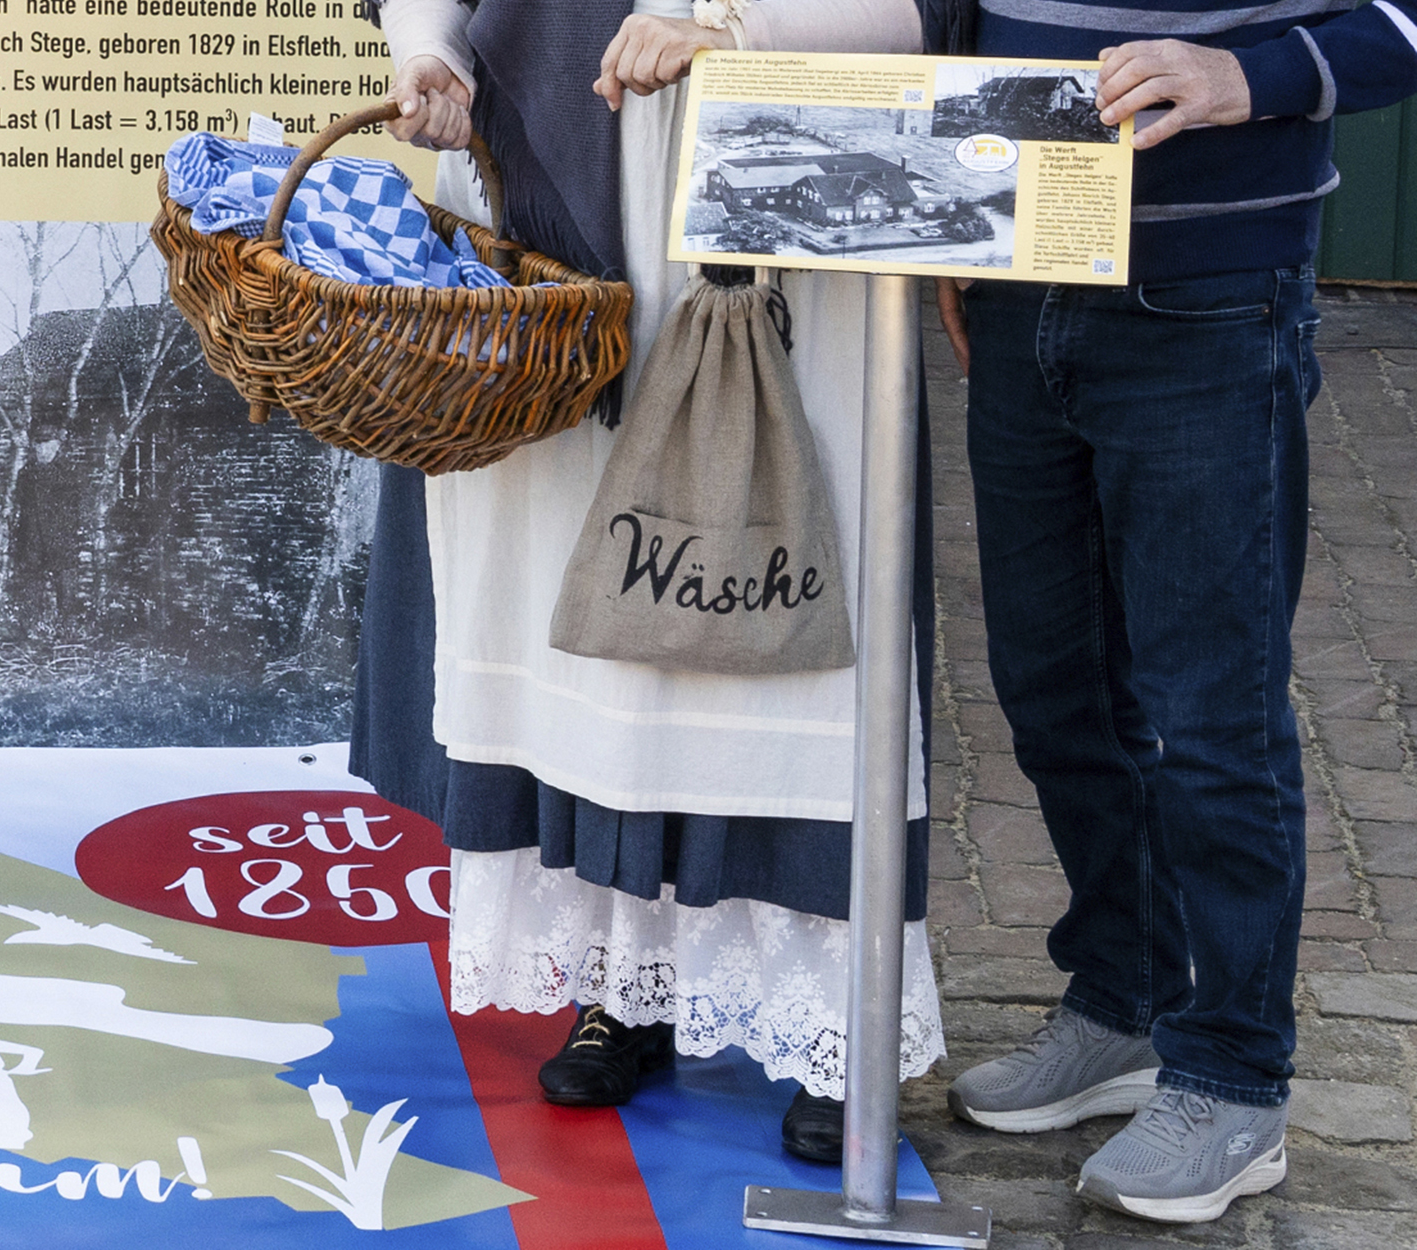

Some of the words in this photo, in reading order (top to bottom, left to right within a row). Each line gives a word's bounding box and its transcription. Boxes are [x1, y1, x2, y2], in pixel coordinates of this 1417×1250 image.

[30, 30, 92, 59] Stege,
[99, 32, 181, 60] geboren
[188, 33, 236, 56] 1829
[242, 34, 260, 56] in
[268, 34, 347, 59] Elsfleth,
[13, 69, 36, 92] Es
[41, 70, 117, 93] wurden
[123, 70, 263, 99] hauptsächlich
[269, 72, 352, 97] kleinere
[44, 108, 60, 132] (1
[70, 108, 113, 131] Last
[145, 109, 199, 133] 3,158
[56, 146, 124, 169] Handel
[130, 153, 166, 176] gen
[609, 513, 825, 614] Wäsche
[188, 807, 403, 853] seit
